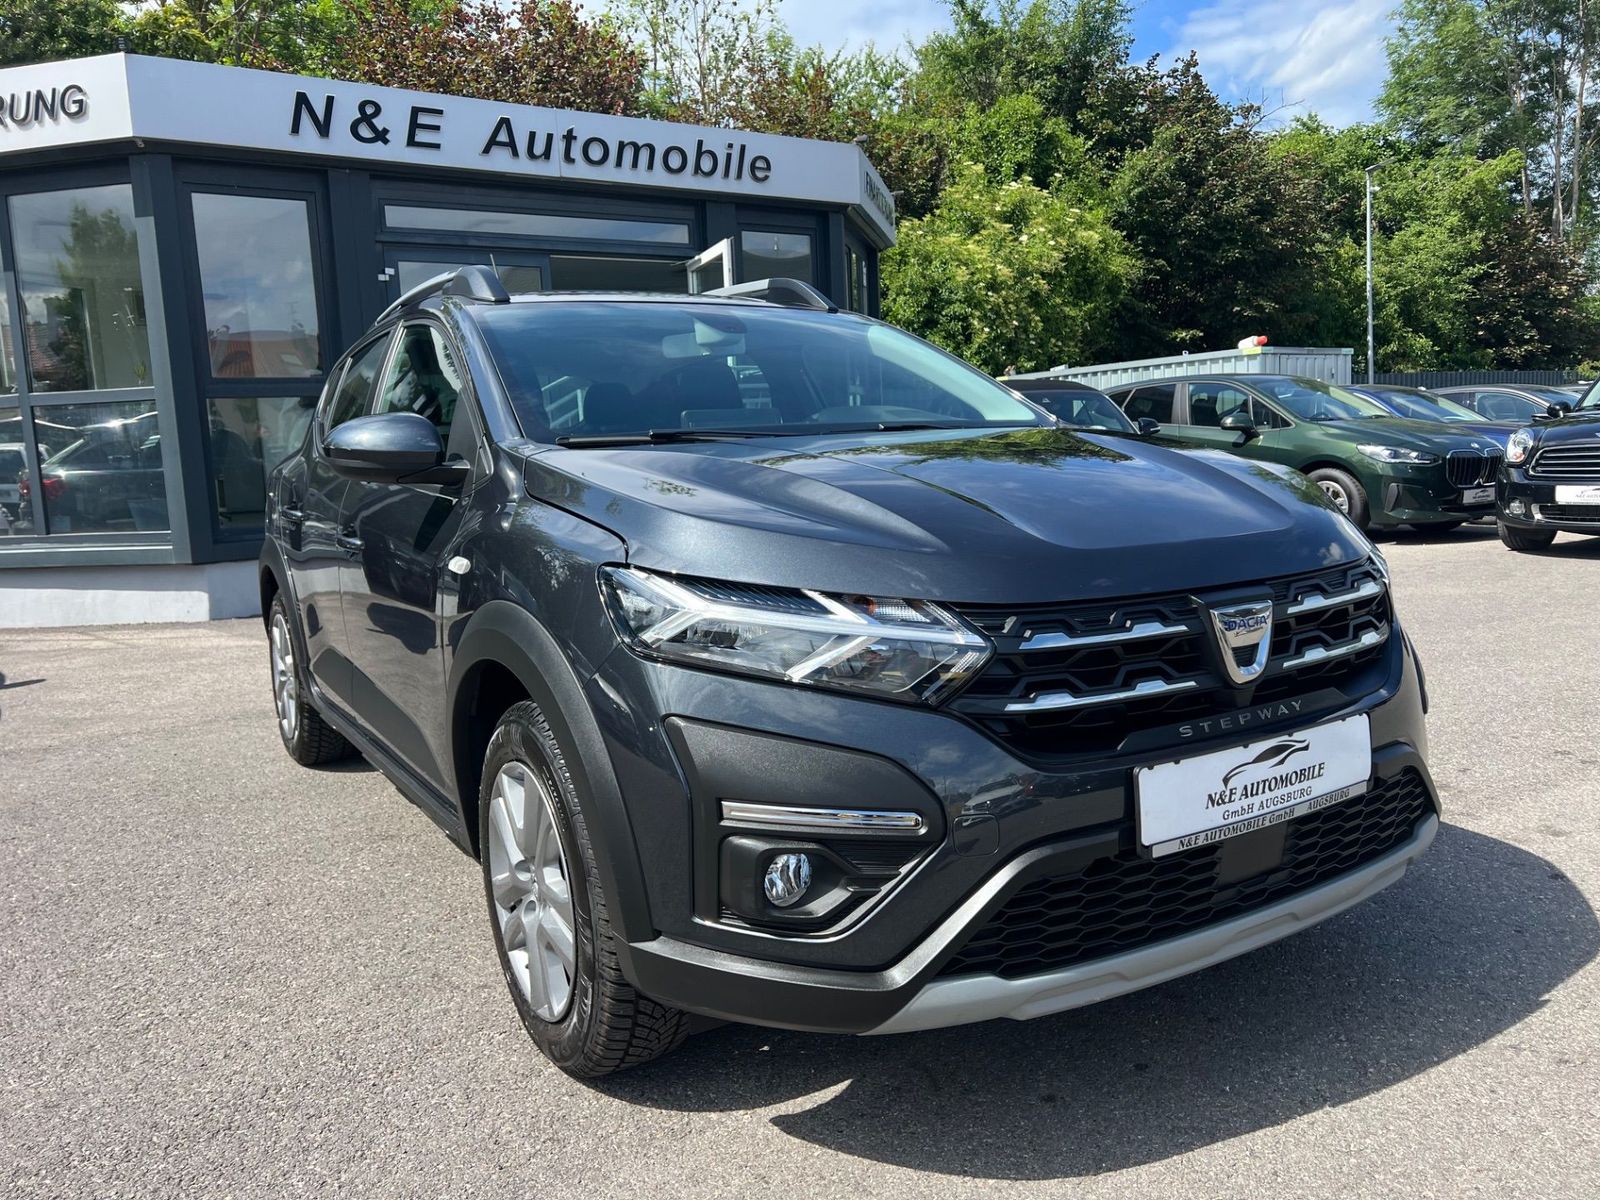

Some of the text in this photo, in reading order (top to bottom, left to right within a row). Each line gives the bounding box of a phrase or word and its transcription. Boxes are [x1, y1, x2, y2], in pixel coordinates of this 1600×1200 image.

[289, 91, 772, 183] N & E Automobile
[1227, 615, 1267, 631] DACIA
[1178, 700, 1303, 737] STEPWAY
[1205, 762, 1325, 810] N&E AUTOMOBILE
[1222, 786, 1313, 821] GmbH AUGSBURG
[1177, 788, 1350, 850] N&E AUTOMOBILE GmbH AUGSBURG
